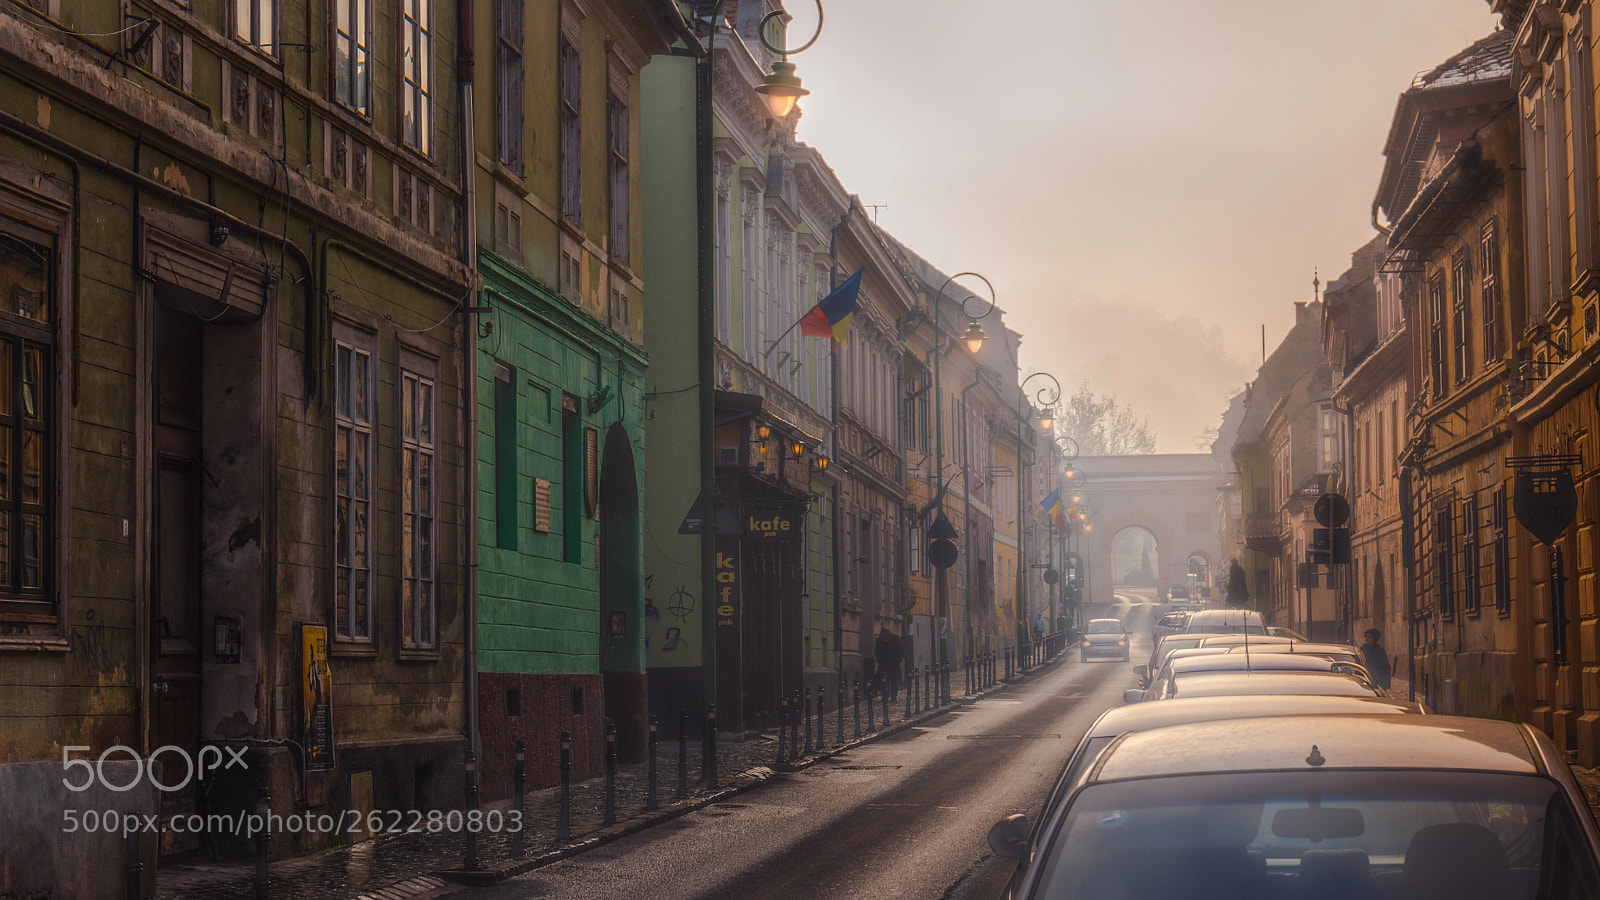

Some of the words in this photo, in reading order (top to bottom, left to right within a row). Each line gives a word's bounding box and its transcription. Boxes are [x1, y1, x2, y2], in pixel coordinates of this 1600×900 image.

[750, 516, 791, 531] kafe
[716, 552, 735, 617] kafe
[718, 619, 733, 627] pub
